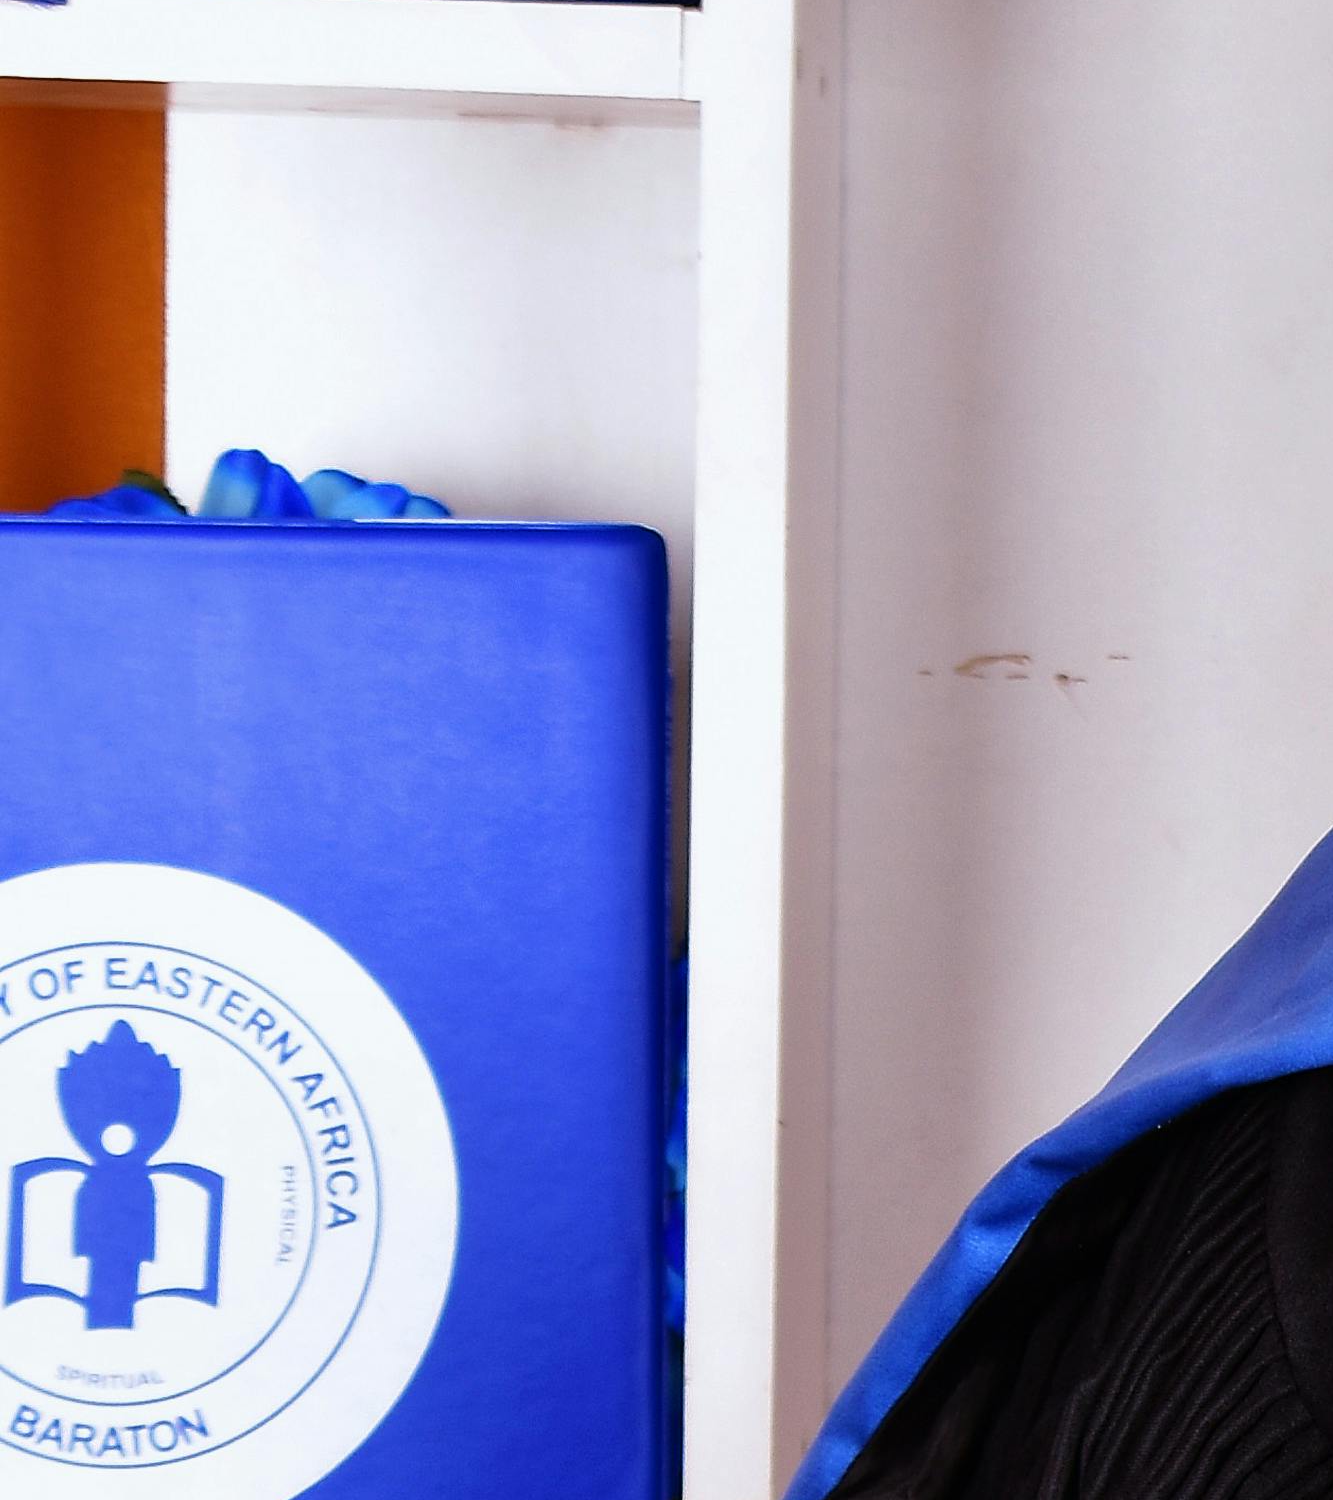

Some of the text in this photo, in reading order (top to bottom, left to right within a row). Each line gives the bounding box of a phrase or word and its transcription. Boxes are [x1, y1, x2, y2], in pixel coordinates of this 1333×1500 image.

[28, 959, 85, 1002] OF
[105, 957, 302, 1065] EASTERN
[292, 1071, 360, 1230] AFRICA
[276, 1164, 298, 1266] PHYSICAL
[56, 1364, 166, 1390] SPIRITUAL
[10, 1404, 210, 1458] BARATON
